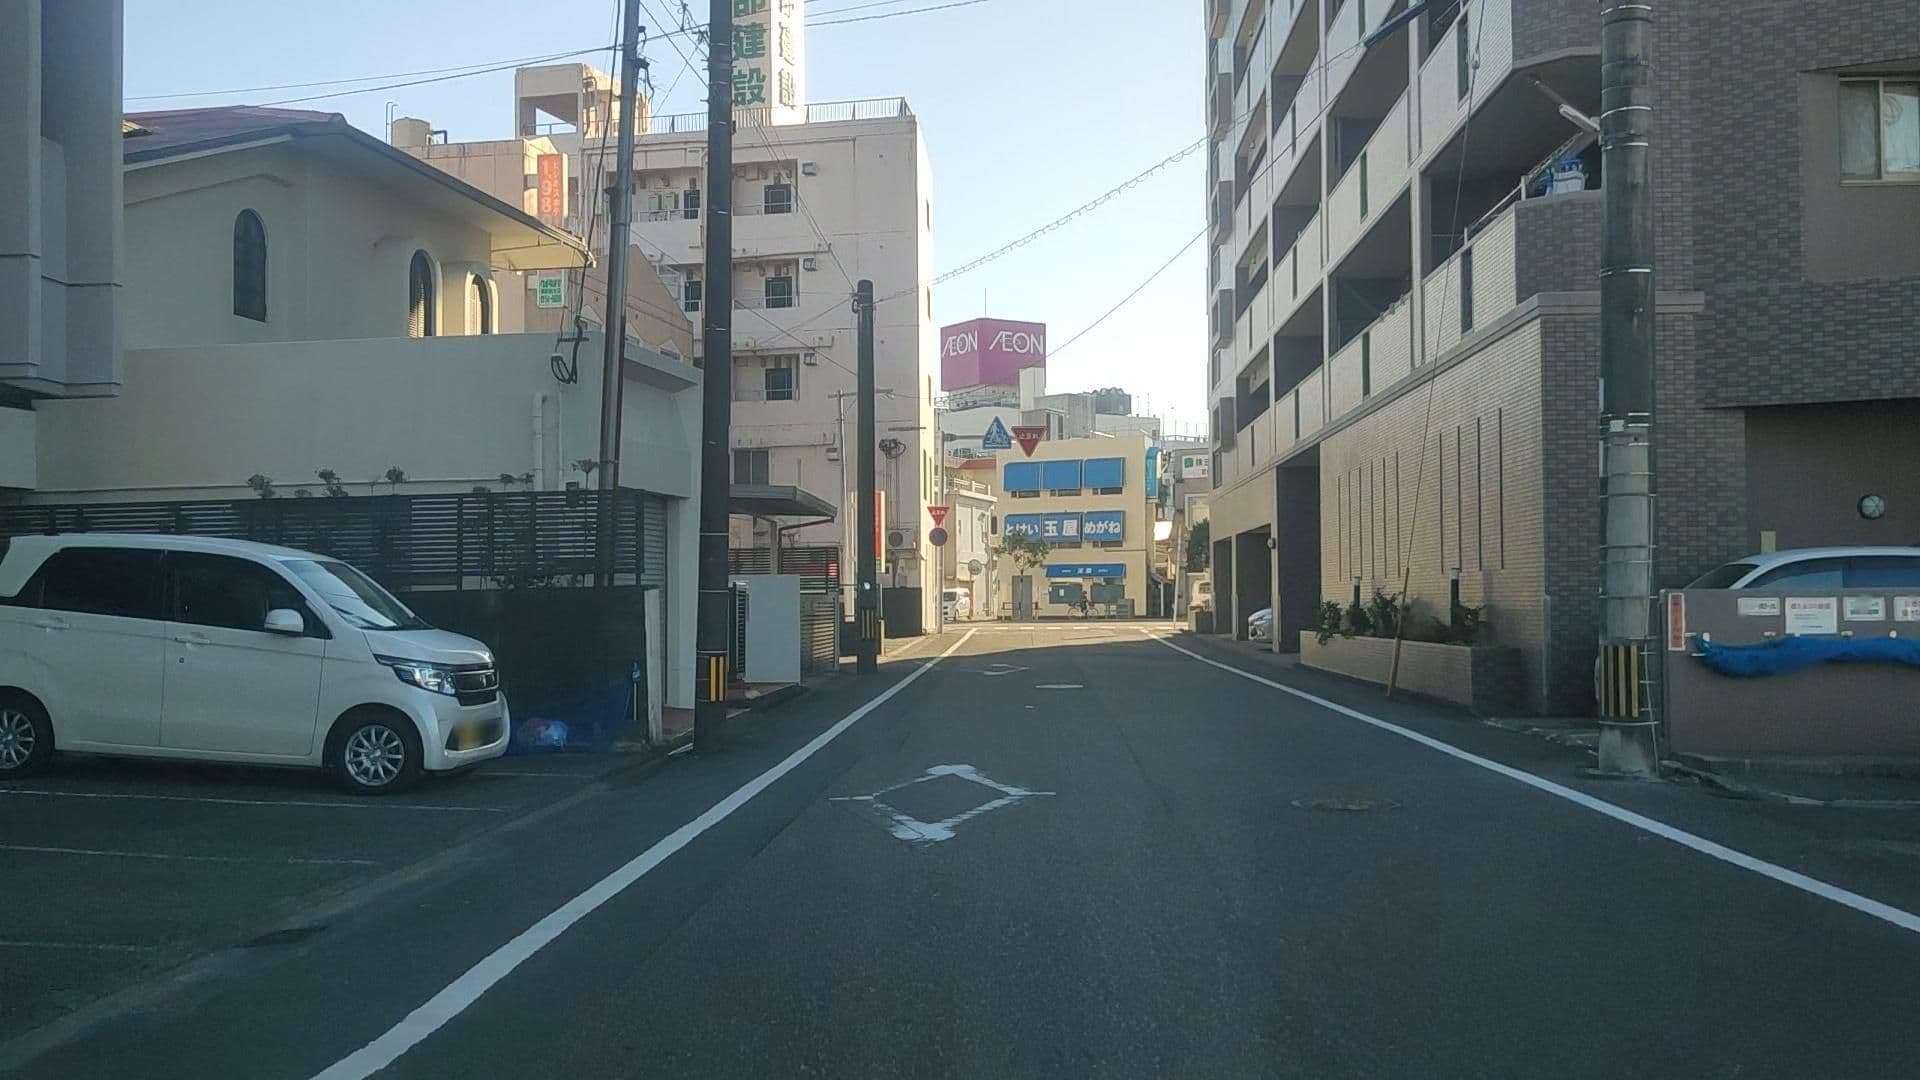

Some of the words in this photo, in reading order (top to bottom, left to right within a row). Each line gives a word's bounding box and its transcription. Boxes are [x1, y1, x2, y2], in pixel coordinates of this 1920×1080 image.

[1005, 523, 1039, 536] とけい
[1043, 519, 1079, 537] 玉屋
[1084, 520, 1121, 534] めがね
